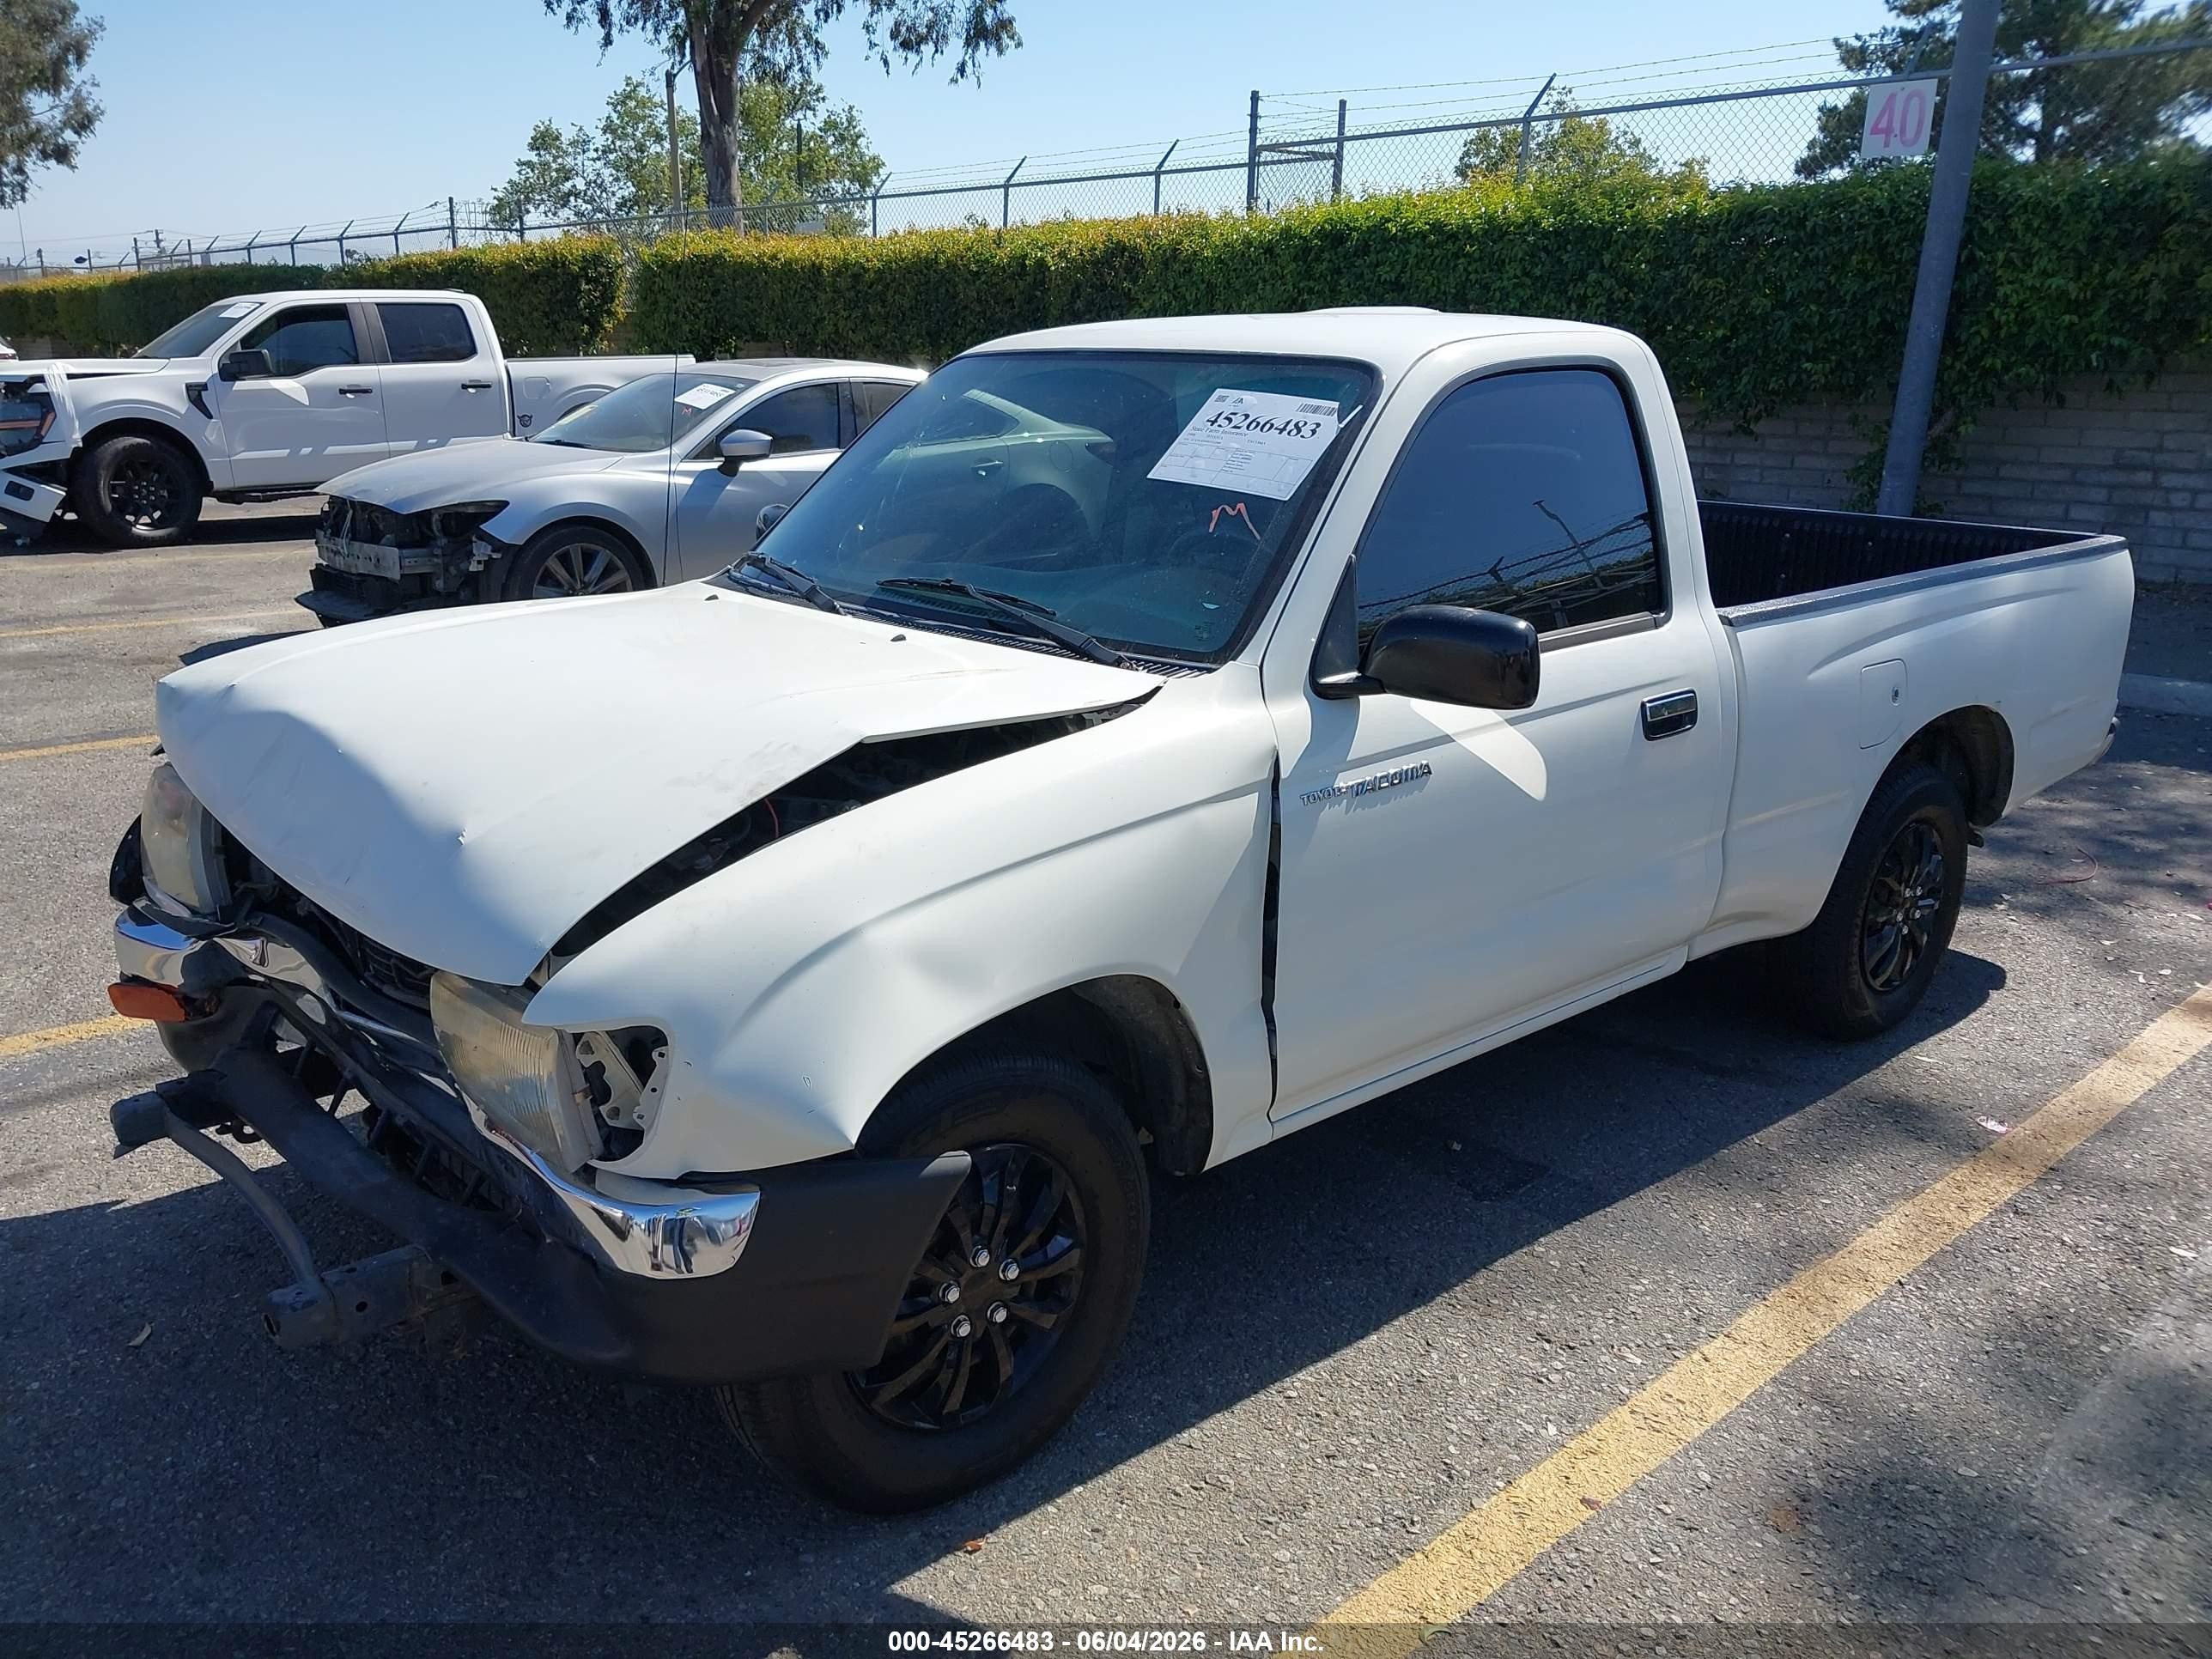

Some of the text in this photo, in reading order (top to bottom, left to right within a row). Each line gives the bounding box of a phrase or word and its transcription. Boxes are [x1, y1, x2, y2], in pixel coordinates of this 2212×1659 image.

[1869, 89, 1926, 149] 40
[1206, 410, 1322, 439] 45266483
[1208, 502, 1261, 541] M
[1348, 760, 1432, 798] TACOMA
